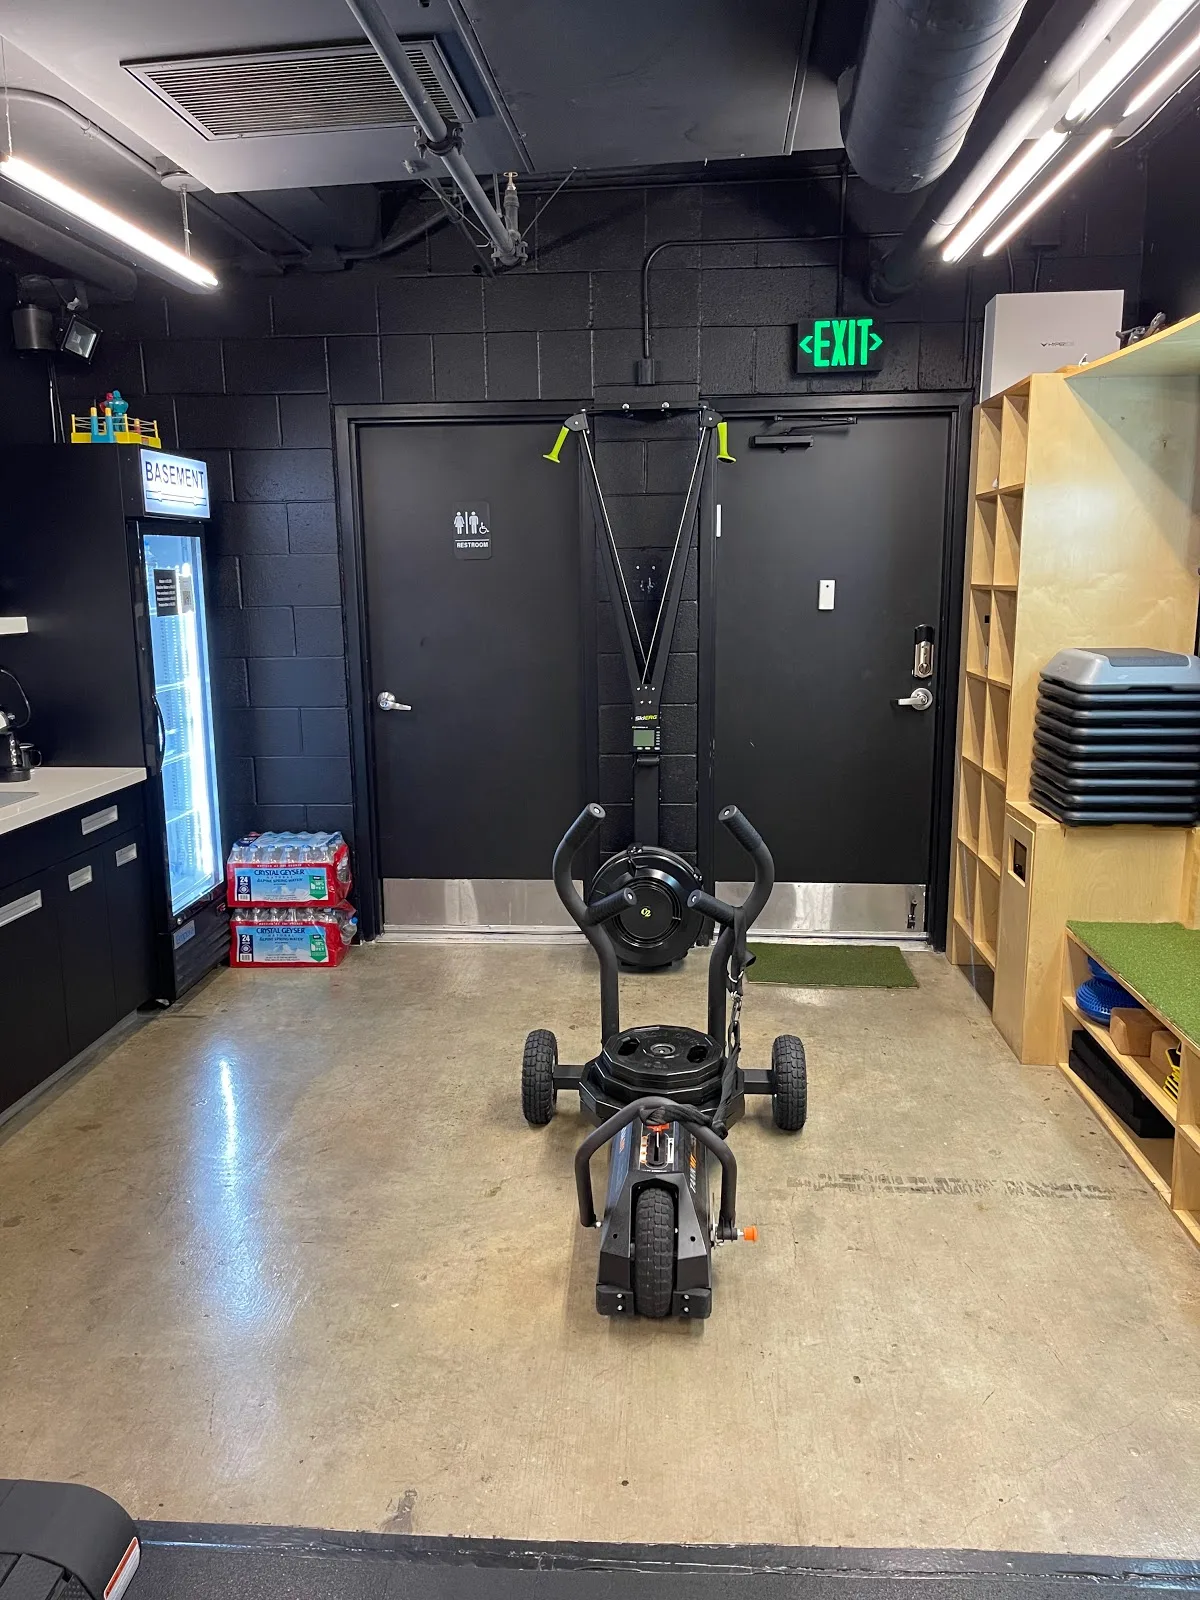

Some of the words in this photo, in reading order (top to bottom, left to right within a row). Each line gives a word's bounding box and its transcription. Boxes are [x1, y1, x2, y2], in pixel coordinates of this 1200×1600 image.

[814, 318, 873, 367] EXIT
[145, 461, 204, 489] BASEMENT
[280, 868, 305, 876] GEYSER
[242, 934, 250, 942] 24
